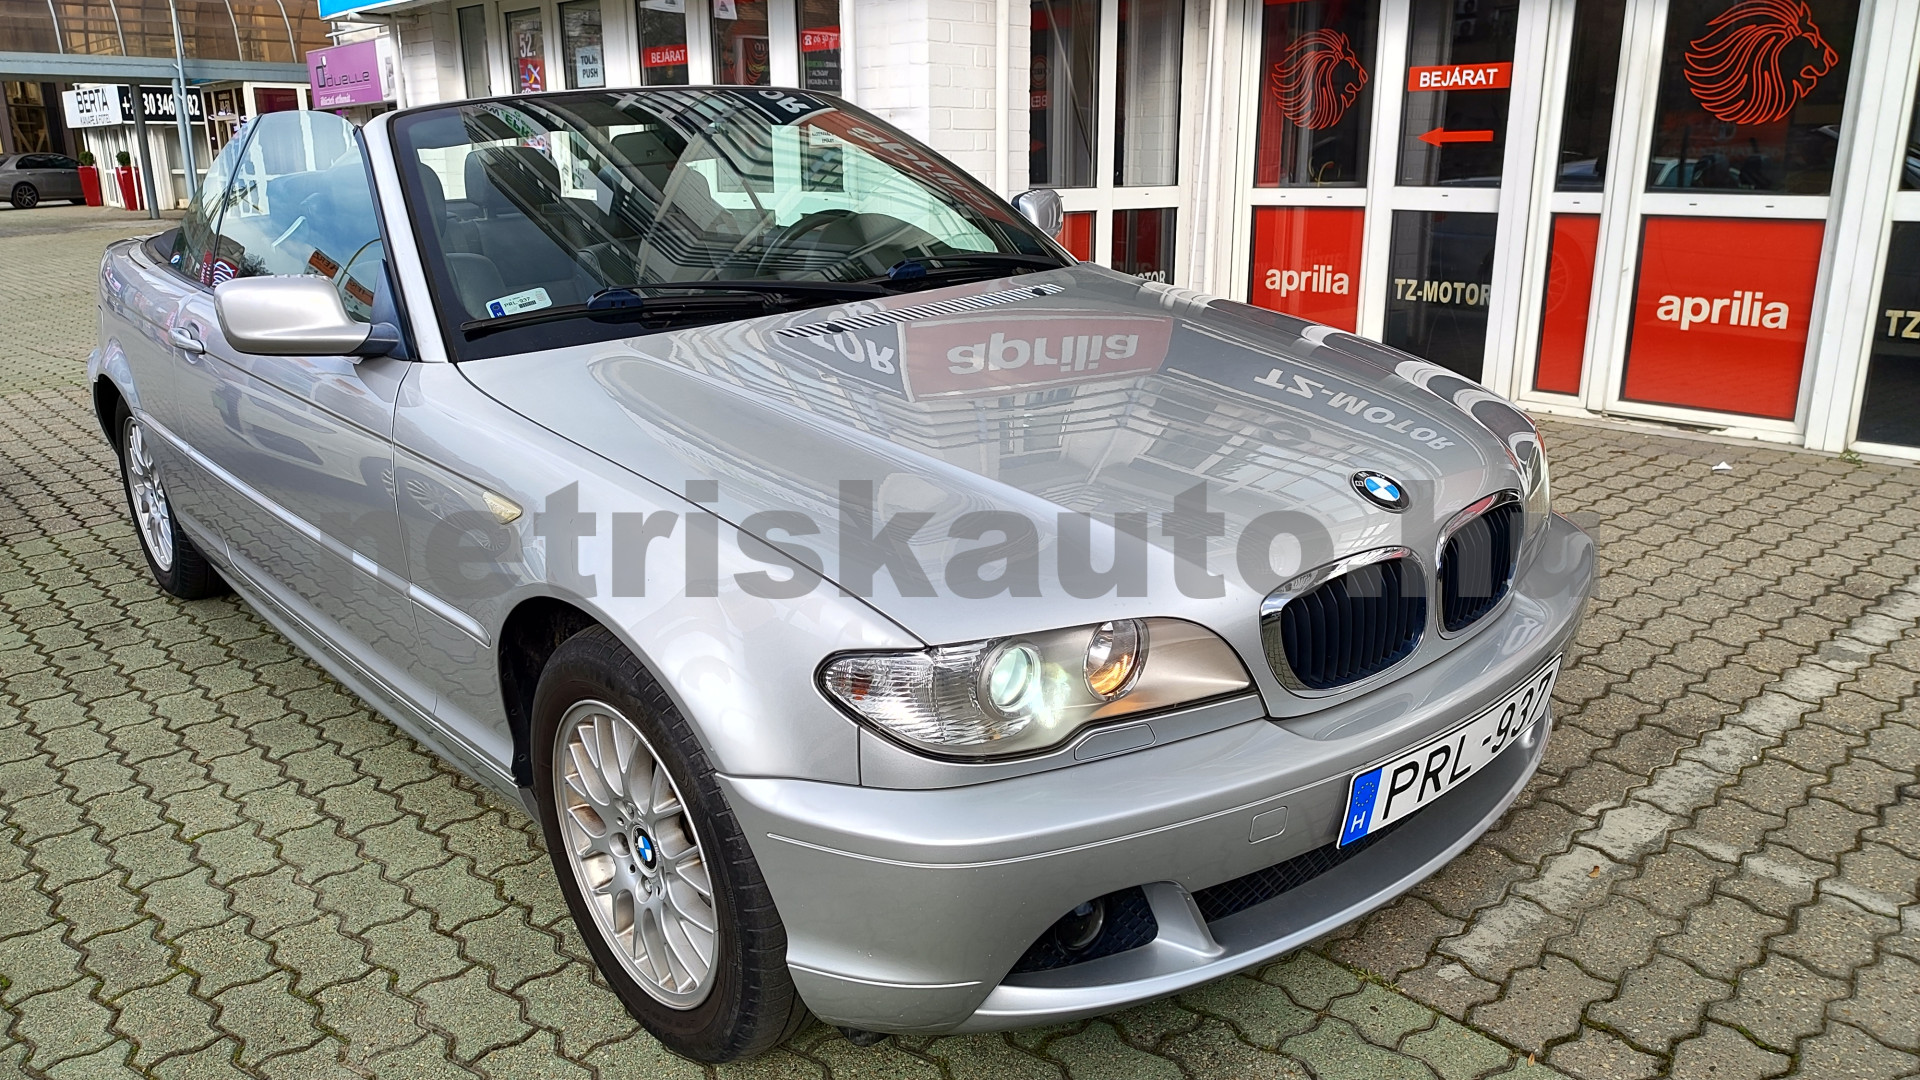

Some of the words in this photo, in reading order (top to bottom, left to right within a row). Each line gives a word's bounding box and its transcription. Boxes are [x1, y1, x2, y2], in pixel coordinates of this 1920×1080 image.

[650, 48, 686, 64] BEJÁRAT
[582, 68, 599, 79] PUSH
[1419, 66, 1499, 88] BEJÁRAT
[75, 89, 111, 114] BERTA
[1265, 264, 1350, 298] aprilia
[1394, 278, 1492, 306] TZ-MOTOR
[1656, 290, 1790, 331] aprilia
[1350, 811, 1367, 833] H
